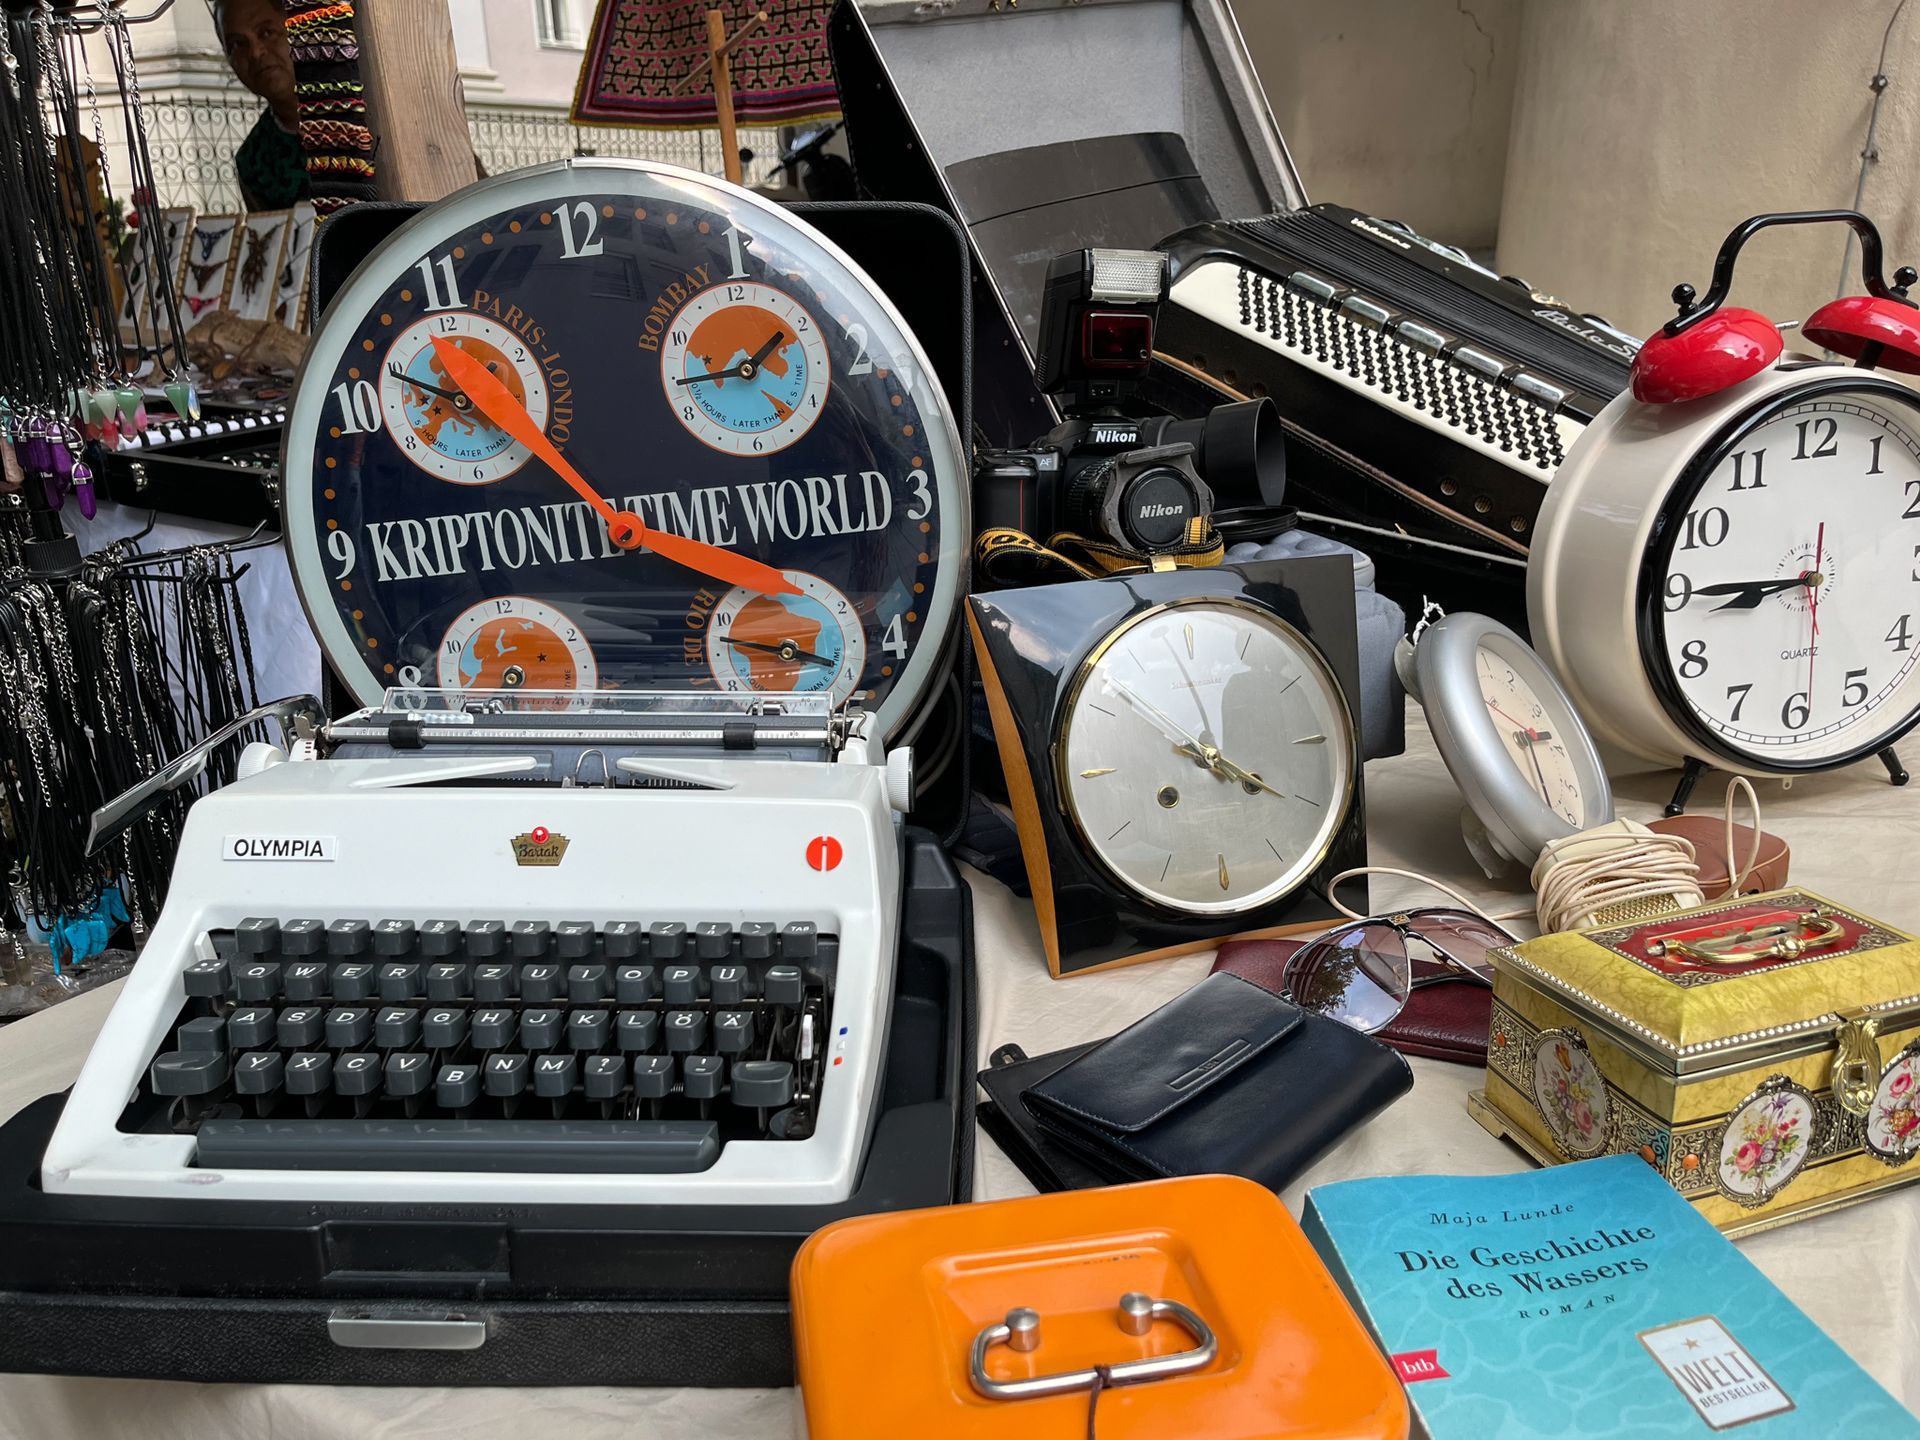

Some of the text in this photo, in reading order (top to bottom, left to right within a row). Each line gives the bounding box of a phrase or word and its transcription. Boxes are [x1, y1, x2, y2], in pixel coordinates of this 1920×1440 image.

[552, 201, 604, 259] 12
[721, 226, 751, 280] 1
[415, 254, 468, 312] 11
[727, 285, 745, 302] 12
[638, 263, 712, 353] BOMBAY
[439, 316, 457, 333] 12
[798, 316, 809, 332] 2
[672, 330, 688, 347] 10
[514, 347, 525, 363] 2
[844, 323, 873, 376] 2
[701, 399, 727, 423] HOURS
[733, 418, 761, 428] LATER
[763, 408, 785, 425] THAN
[794, 364, 803, 386] TIME
[808, 393, 818, 409] 4
[332, 379, 382, 435] 10
[683, 406, 695, 421] 8
[405, 435, 416, 451] 8
[421, 428, 449, 452] HOURS
[455, 448, 483, 457] LATER
[485, 436, 507, 454] THAN
[752, 436, 764, 452] 6
[1095, 430, 1137, 443] Nikon
[1791, 417, 1838, 461] 12
[1040, 458, 1052, 467] AF
[1865, 435, 1885, 476] 1
[473, 464, 484, 480] 6
[1727, 448, 1768, 492] 11
[905, 469, 932, 521] 3
[1901, 480, 1920, 519] 2
[1139, 503, 1183, 519] Nikon
[366, 470, 892, 583] KRIPTONITE TIME WORLD
[1680, 506, 1730, 551] 10
[327, 530, 356, 580] 9
[1664, 572, 1692, 613] 9
[496, 599, 513, 615] 12
[686, 587, 717, 629] RIO
[837, 601, 847, 615] 2
[716, 611, 732, 627] 10
[566, 629, 578, 643] 2
[882, 613, 909, 660] 4
[1884, 614, 1913, 653] 4
[446, 639, 461, 655] 10
[683, 637, 704, 667] DE
[1781, 646, 1819, 661] QUARTZ
[1678, 639, 1709, 679] 8
[564, 669, 572, 688] TIME
[844, 667, 855, 681] 4
[398, 665, 429, 712] 8
[804, 680, 824, 691] HAN
[1842, 667, 1869, 707] 5
[1726, 683, 1754, 722] 7
[1781, 692, 1810, 730] 6
[233, 839, 324, 857] OLYMPIA
[248, 967, 265, 976] Q
[295, 967, 316, 976] W
[342, 967, 362, 976] E
[389, 968, 406, 976] R
[439, 968, 455, 976] T
[482, 968, 501, 977] Z
[531, 969, 547, 977] U
[582, 969, 590, 978] I
[625, 970, 641, 978] O
[672, 970, 688, 979] P
[236, 1012, 256, 1022] A
[288, 1012, 306, 1022] S
[336, 1012, 355, 1022] D
[386, 1012, 405, 1022] F
[433, 1013, 451, 1023] G
[481, 1013, 500, 1023] H
[529, 1014, 546, 1023] J
[577, 1014, 594, 1024] K
[628, 1015, 641, 1025] L
[250, 1057, 268, 1068] Y
[295, 1057, 316, 1068] X
[347, 1058, 365, 1068] C
[400, 1058, 417, 1069] V
[495, 1059, 514, 1070] N
[541, 1060, 564, 1070] M
[447, 1071, 464, 1082] B
[1430, 1203, 1576, 1227] Maja Lunde
[1395, 1224, 1656, 1273] Die Geschichte
[1446, 1255, 1649, 1300] des Wassers
[1519, 1294, 1617, 1319] ROMAN
[1401, 1360, 1435, 1375] btb
[1674, 1351, 1755, 1395] WELT
[1699, 1380, 1770, 1409] BESTSELLER
